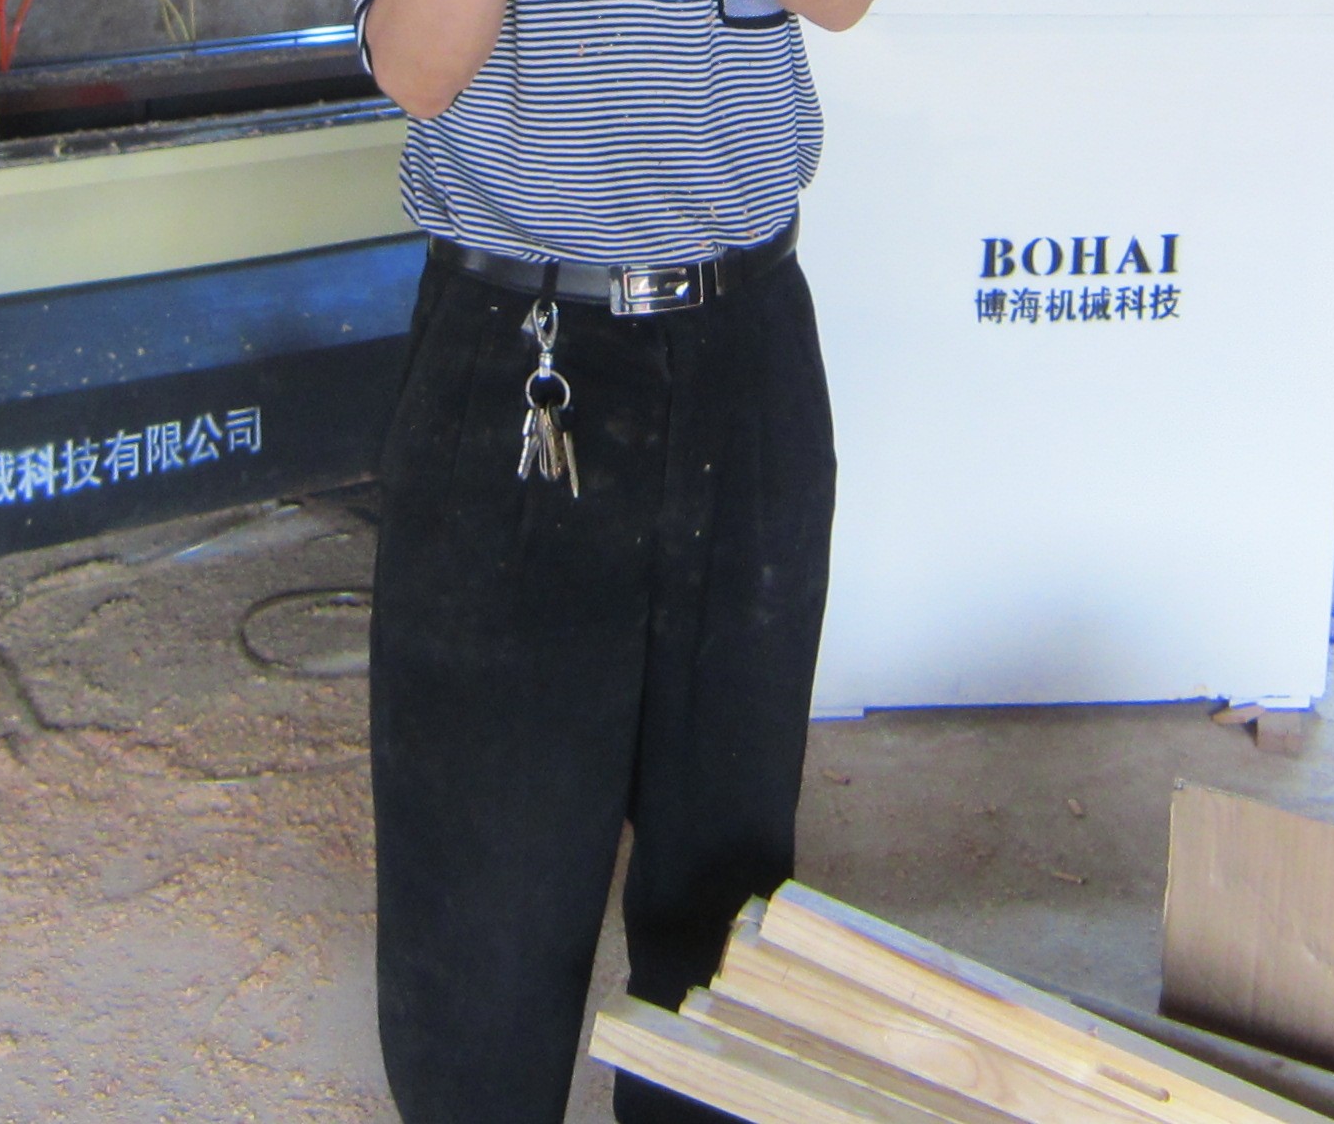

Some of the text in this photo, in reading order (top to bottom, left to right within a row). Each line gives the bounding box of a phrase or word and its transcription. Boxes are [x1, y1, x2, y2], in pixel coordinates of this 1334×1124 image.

[979, 234, 1180, 278] BOHAI
[974, 283, 1182, 324] 博海机械科技
